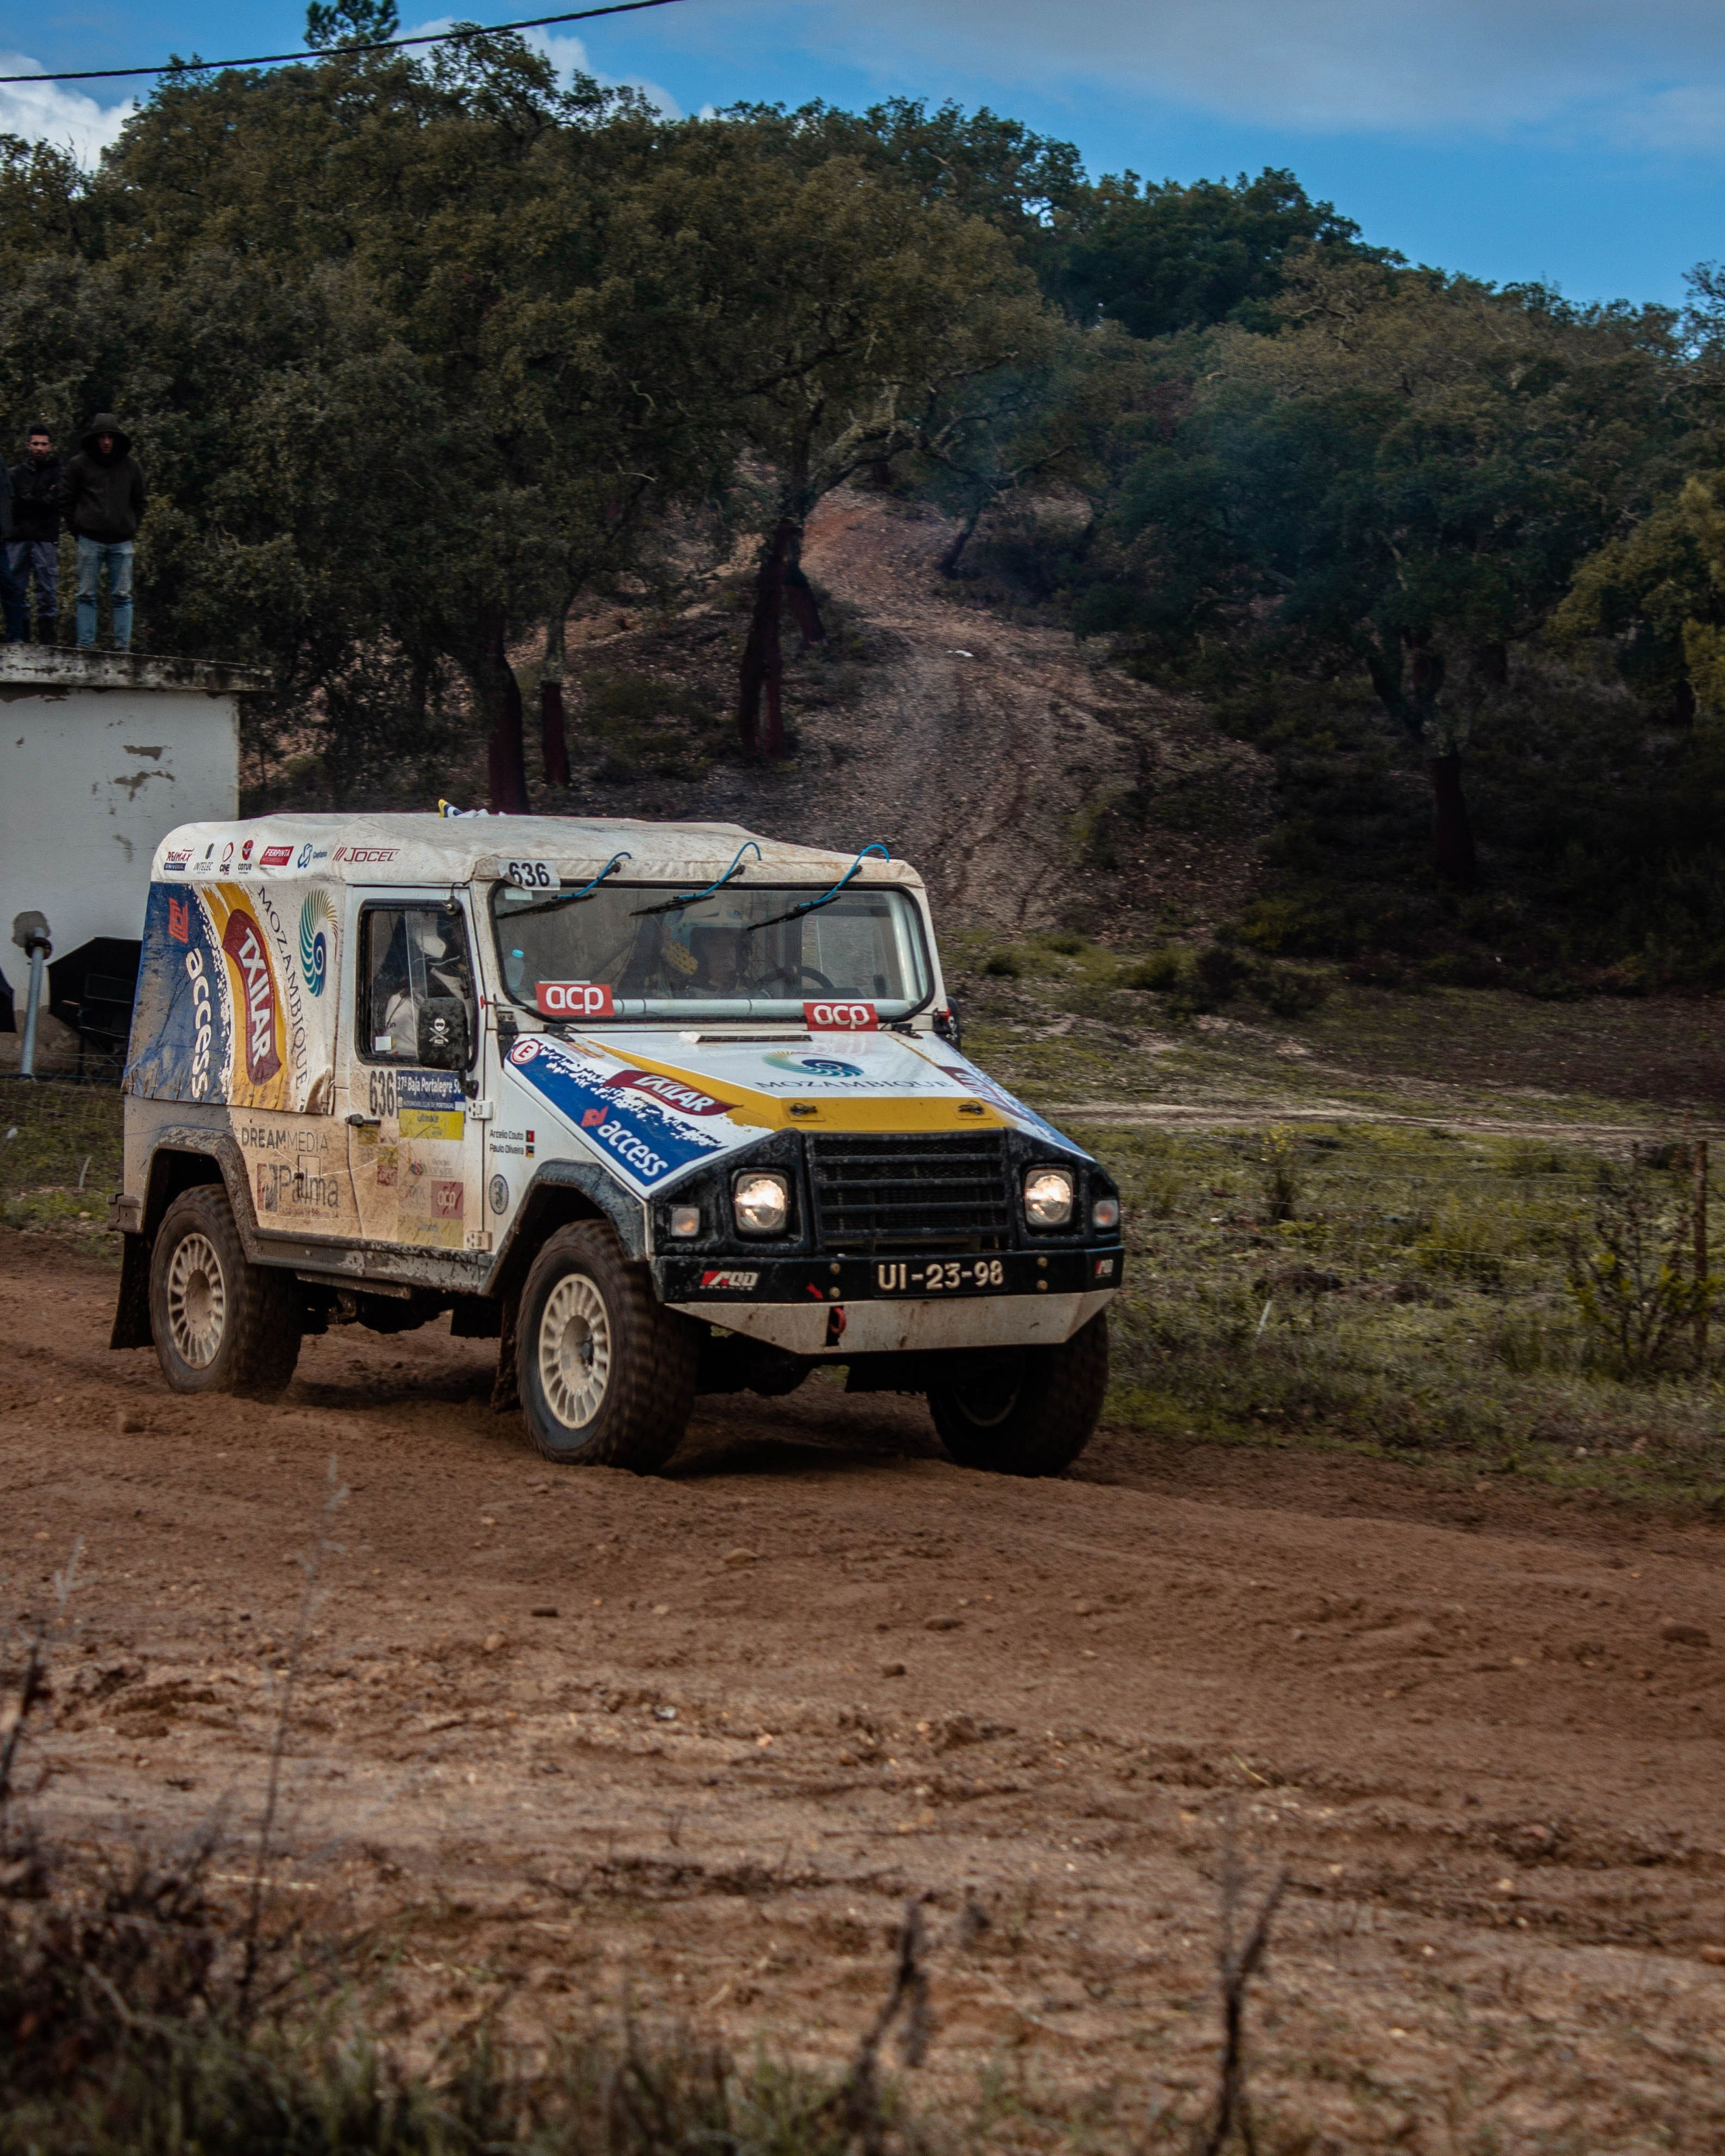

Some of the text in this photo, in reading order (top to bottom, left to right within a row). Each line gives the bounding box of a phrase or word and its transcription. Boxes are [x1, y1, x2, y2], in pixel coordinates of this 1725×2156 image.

[193, 862, 214, 870] INTELEC
[344, 848, 400, 862] JOCEL
[509, 862, 550, 887] 636
[239, 927, 271, 1067] TXILAR
[257, 887, 309, 1089] MOZAMBIQUE
[546, 986, 604, 1014] acp
[185, 947, 212, 1098] access
[813, 1005, 870, 1029] acp
[370, 1071, 395, 1117] 636
[407, 1076, 420, 1096] Baja
[421, 1077, 453, 1097] Portalegre
[755, 1080, 953, 1089] MOZAMBIQUE
[489, 1143, 505, 1153] Paulo
[509, 1131, 524, 1140] Couto
[598, 1120, 668, 1176] access
[279, 1165, 340, 1207] Palma
[878, 1260, 1004, 1290] UI-23-98
